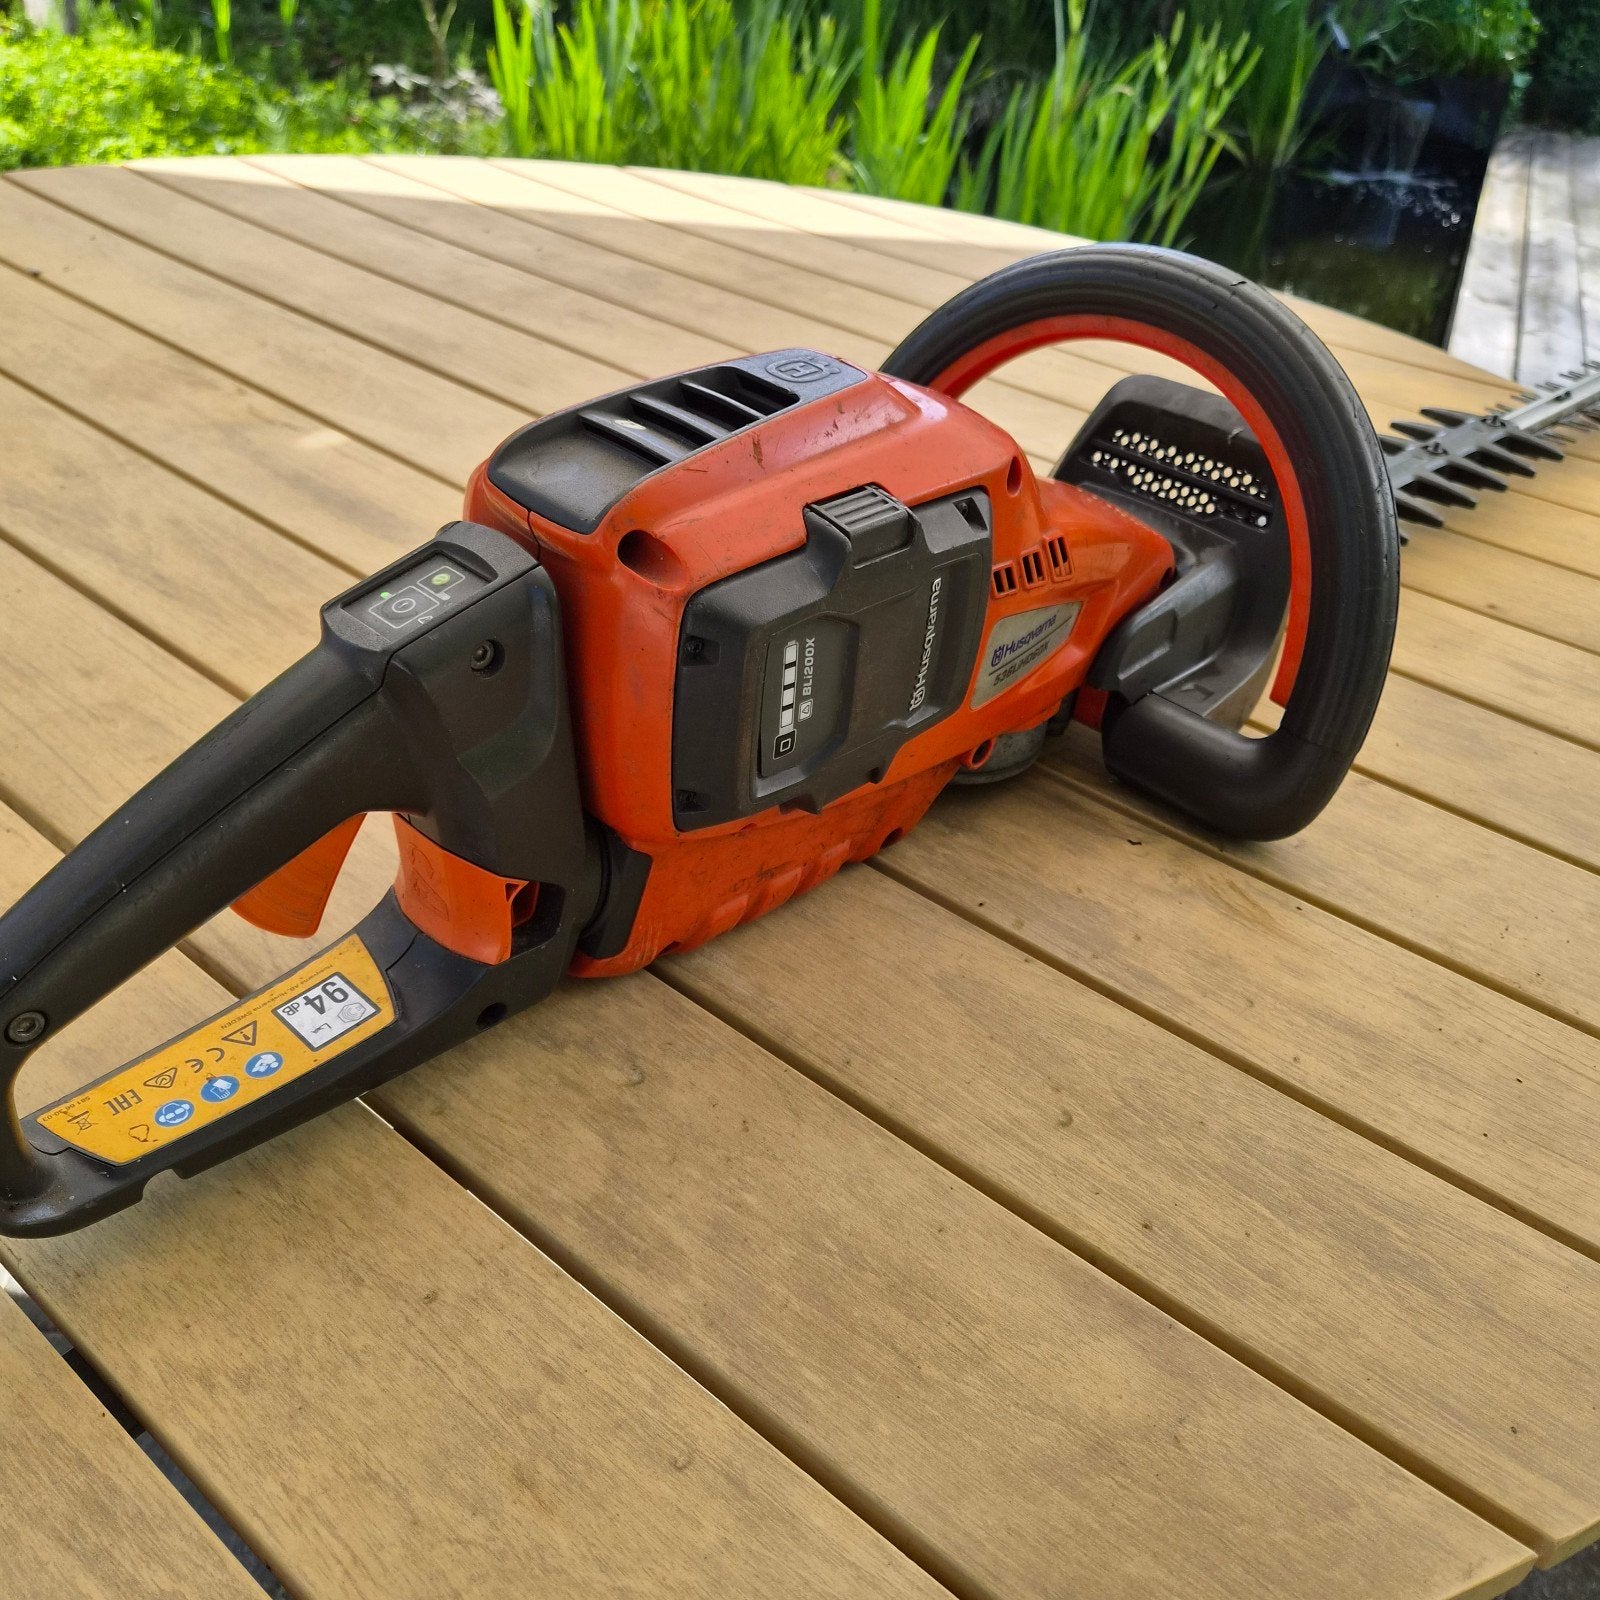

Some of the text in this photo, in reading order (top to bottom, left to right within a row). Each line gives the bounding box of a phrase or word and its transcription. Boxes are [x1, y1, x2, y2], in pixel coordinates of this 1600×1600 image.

[916, 577, 942, 685] Husqvarna
[1004, 615, 1057, 658] Husqvarna
[802, 637, 816, 697] BLi200X
[283, 982, 349, 1017] 94 dB
[221, 1009, 254, 1030] SWEDEN
[184, 1047, 225, 1073] CE
